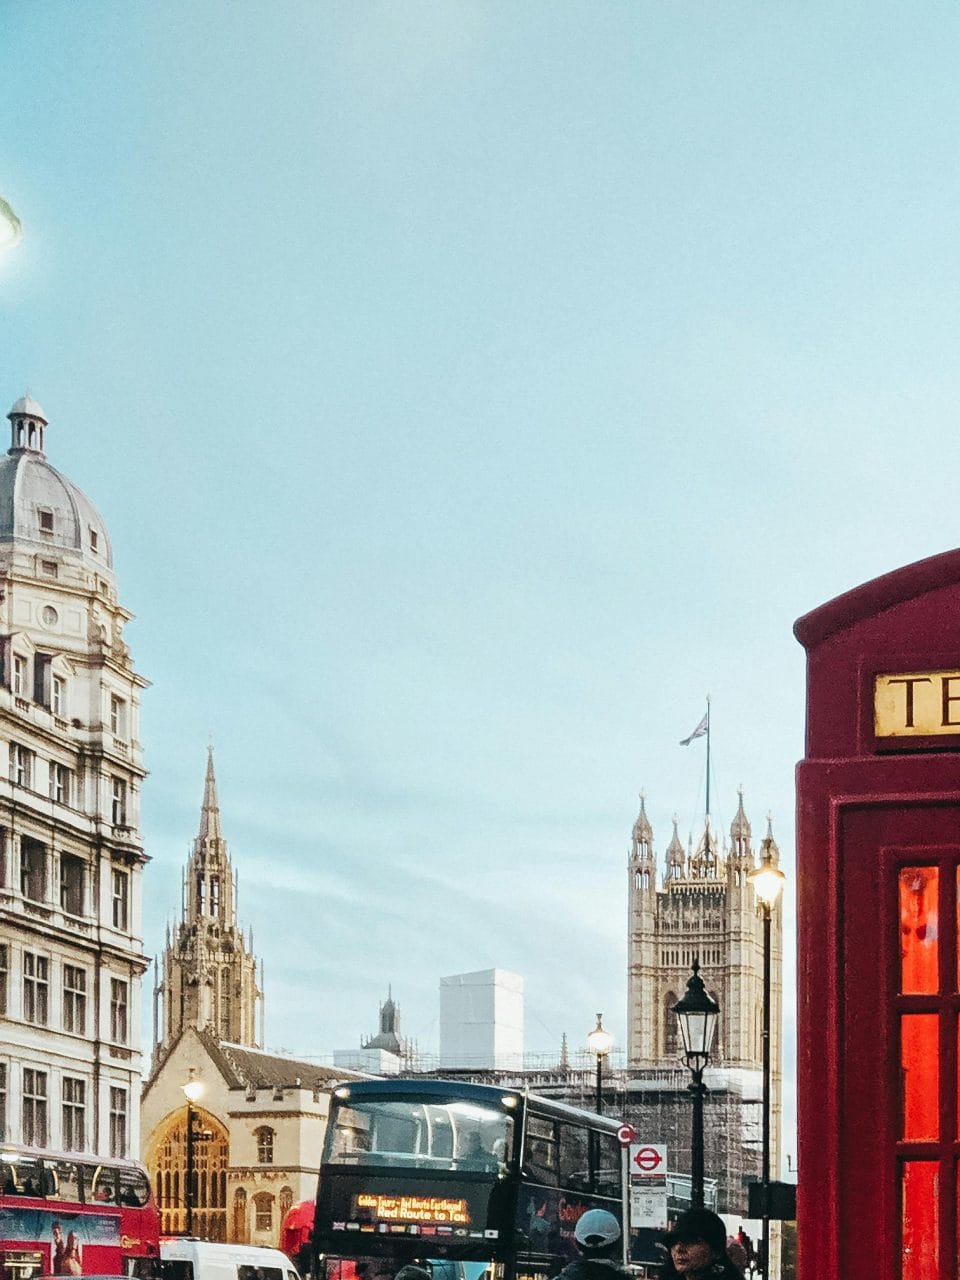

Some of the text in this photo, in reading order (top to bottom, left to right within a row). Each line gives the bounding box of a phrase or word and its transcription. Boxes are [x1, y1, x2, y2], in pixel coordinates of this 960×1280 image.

[617, 1126, 631, 1143] C
[377, 1206, 398, 1218] Red
[399, 1207, 432, 1220] Route
[434, 1209, 446, 1221] to
